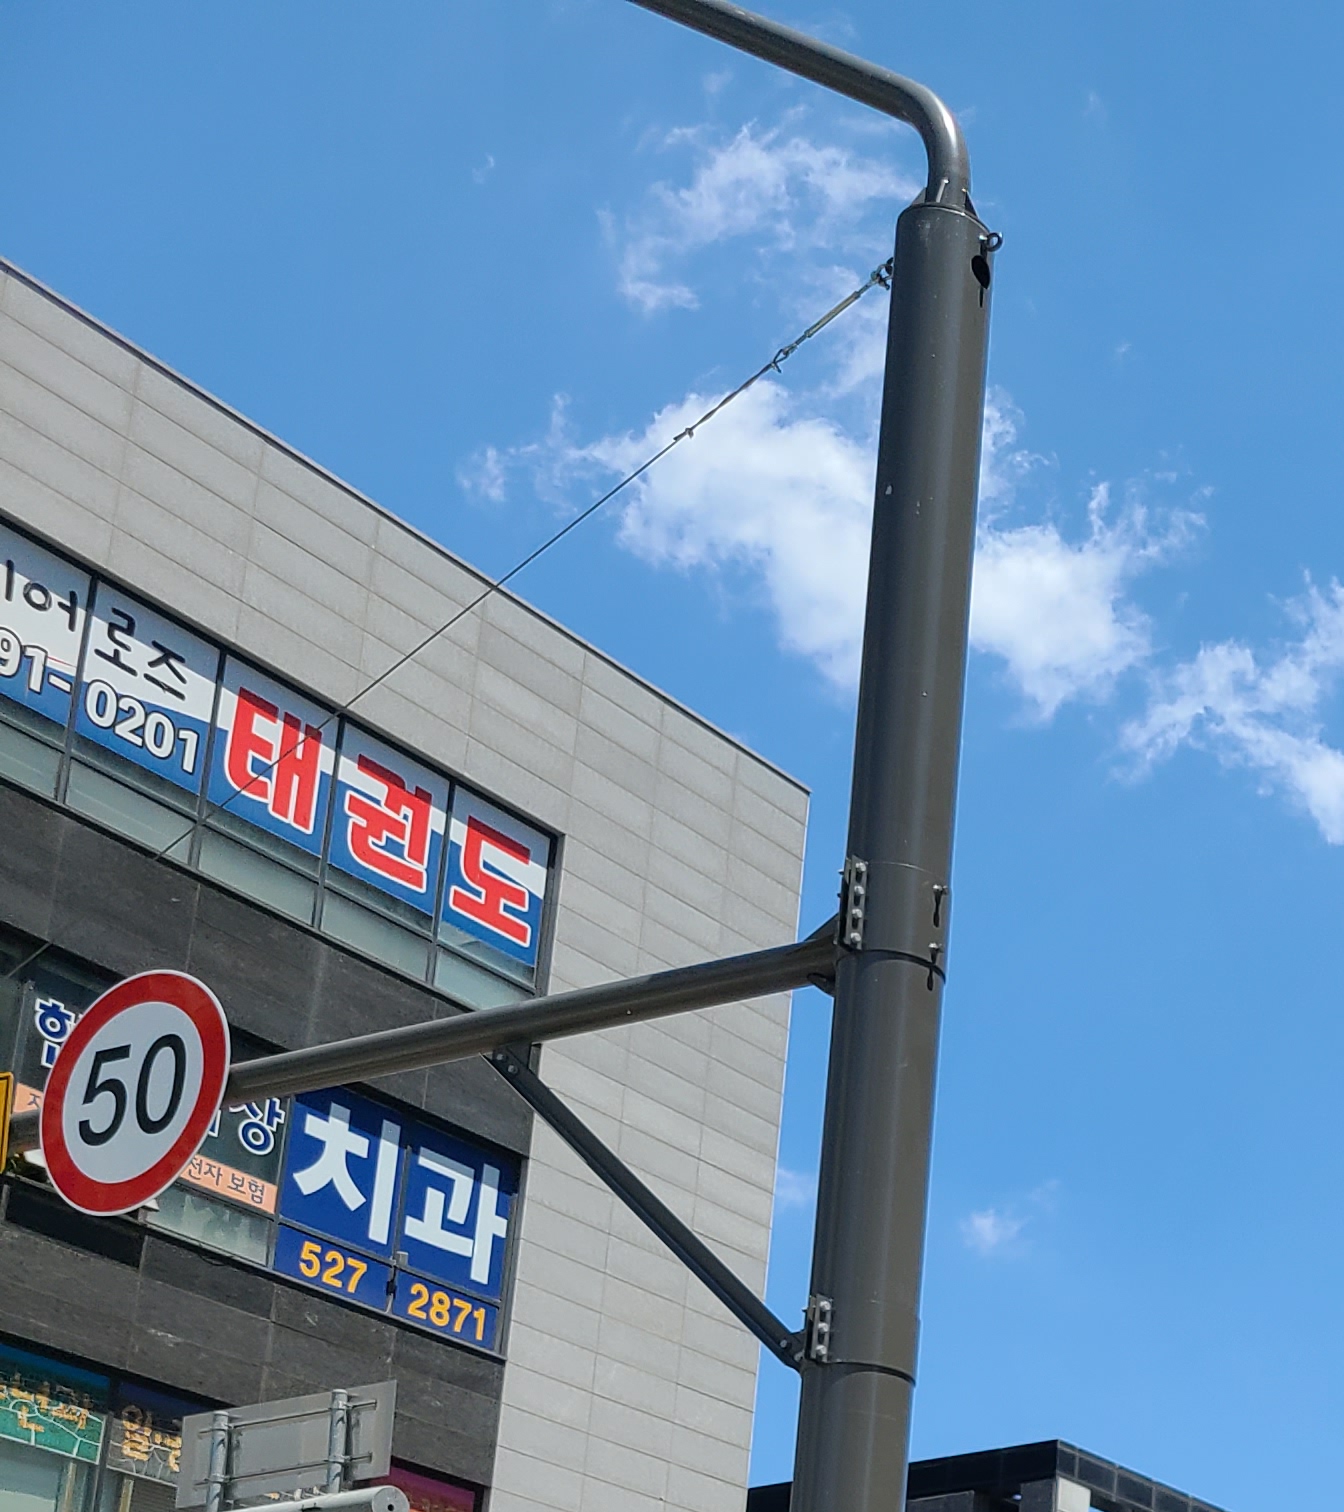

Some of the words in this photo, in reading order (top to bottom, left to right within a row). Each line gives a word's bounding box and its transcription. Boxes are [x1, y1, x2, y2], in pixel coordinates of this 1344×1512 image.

[224, 685, 532, 948] 태권도
[78, 1033, 187, 1147] 50
[227, 1173, 266, 1205] 보험
[292, 1101, 508, 1285] 치과
[299, 1240, 368, 1293] 527
[407, 1283, 486, 1341] 2871
